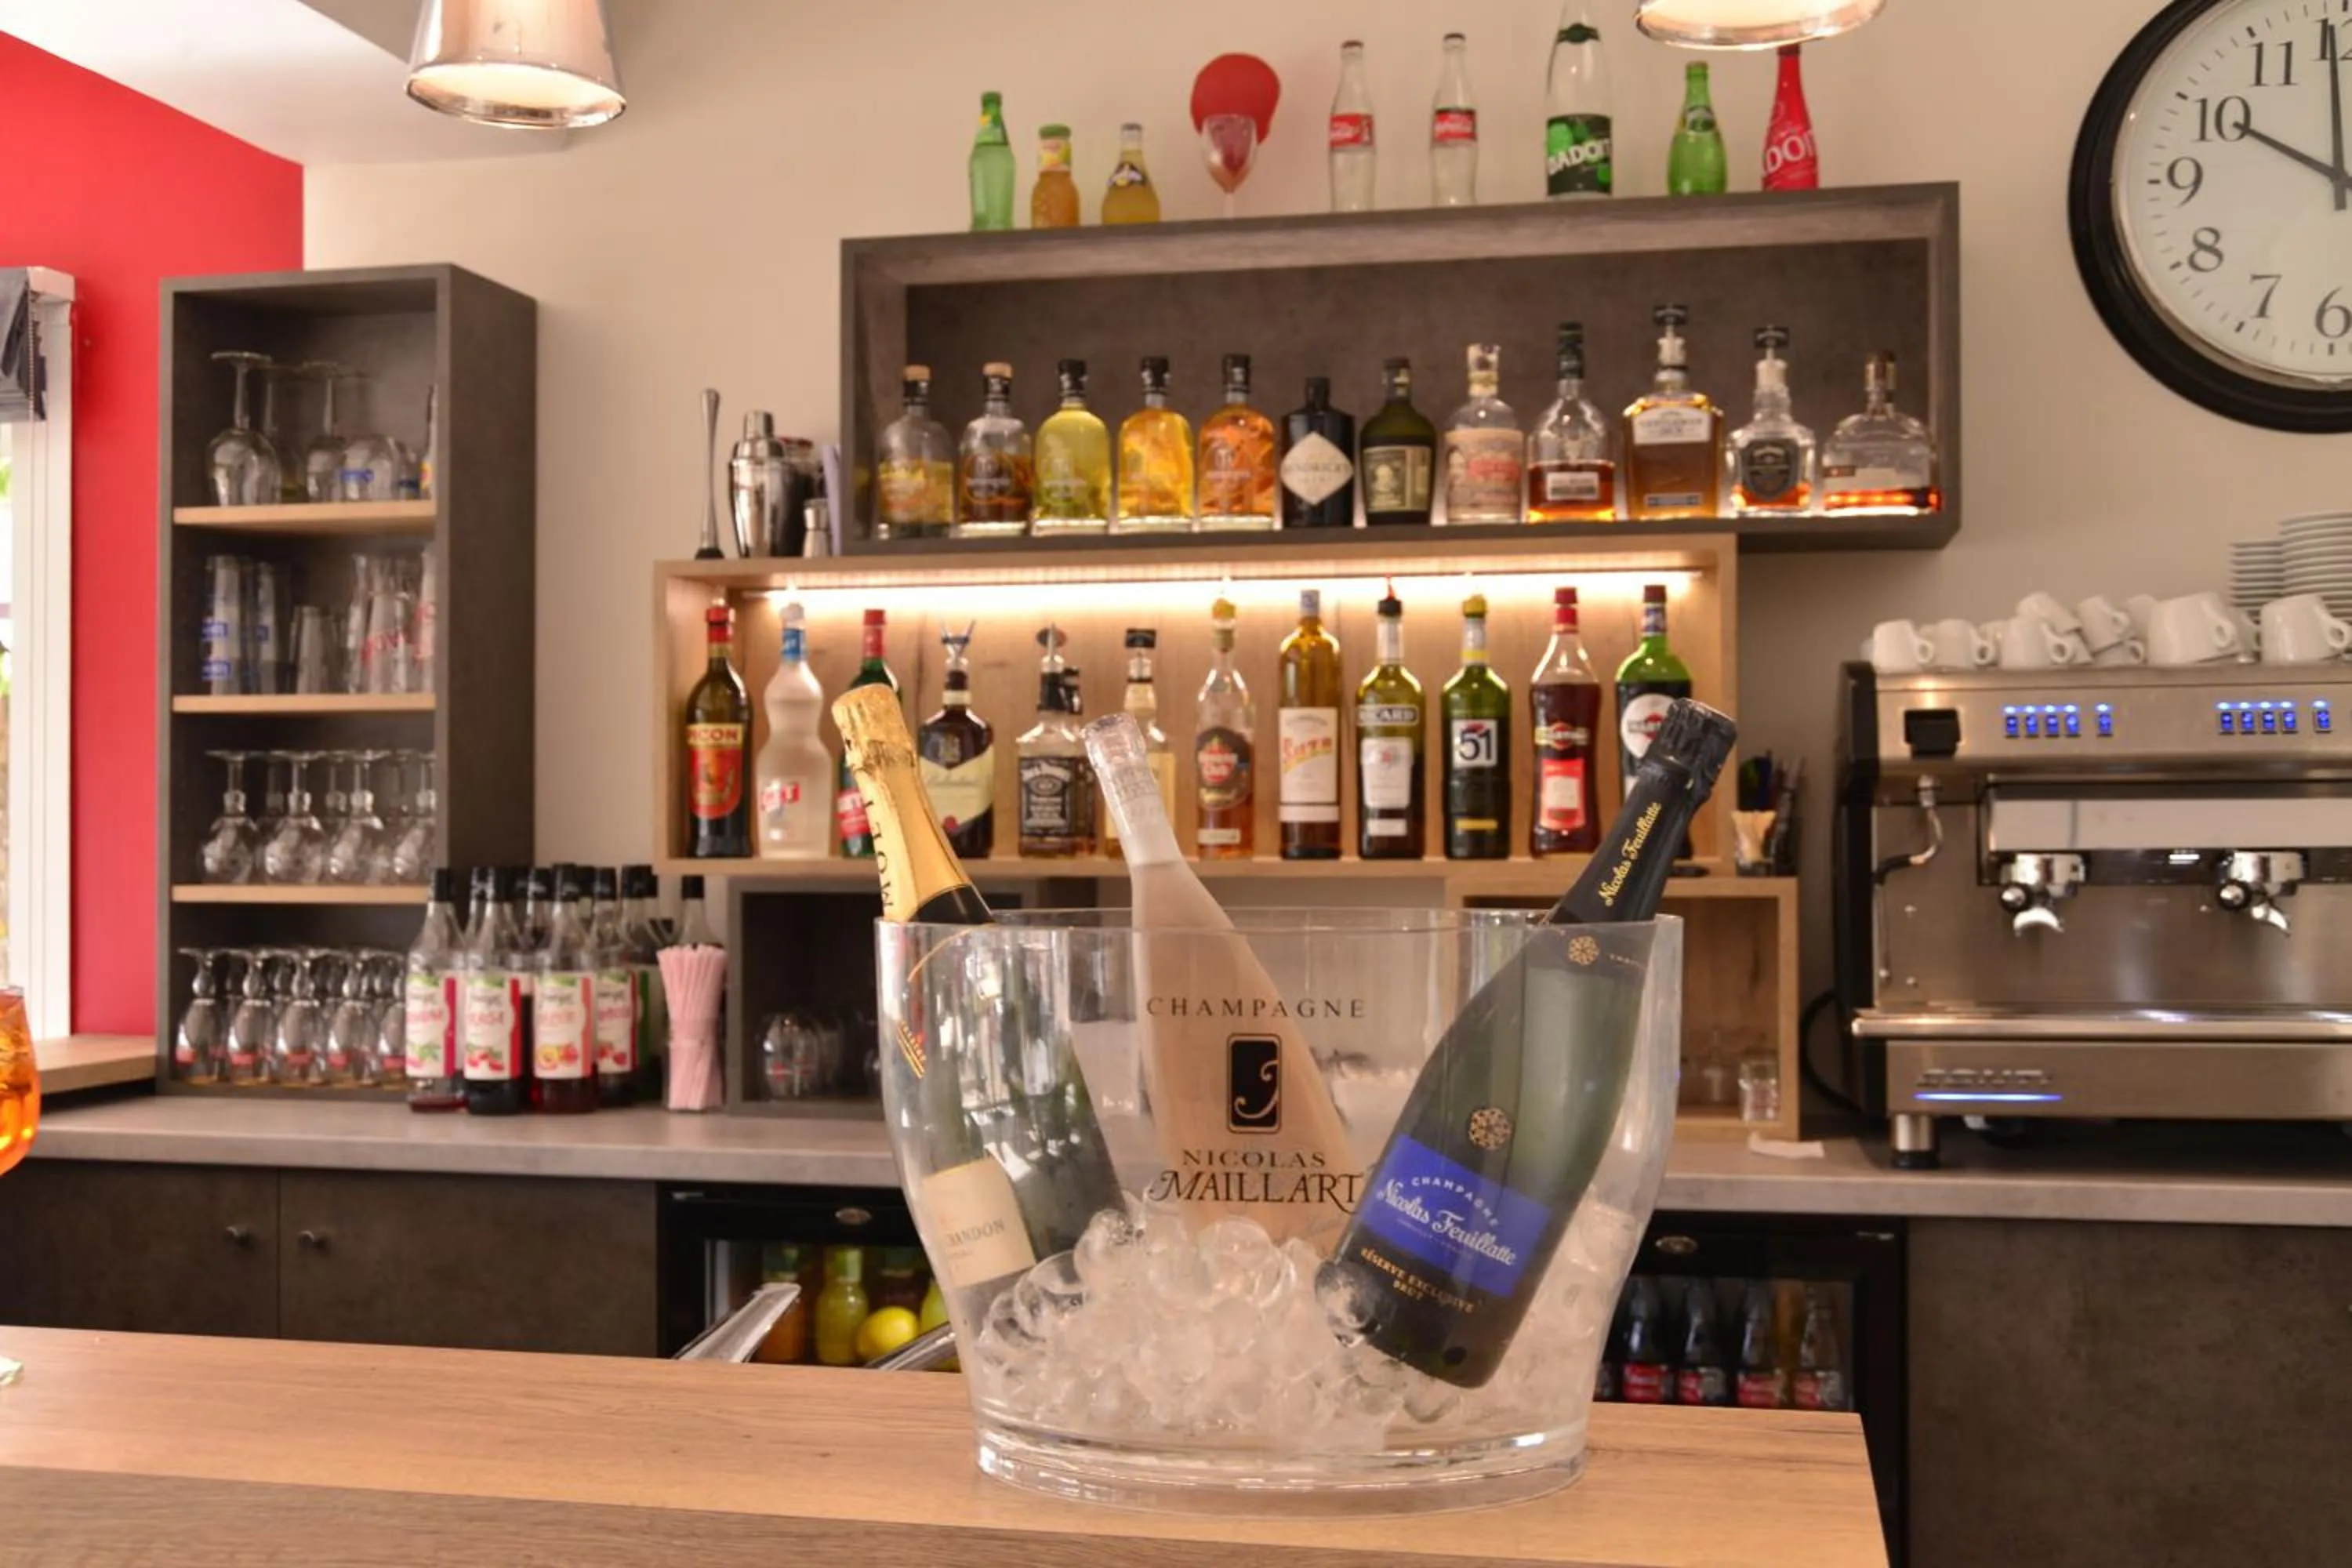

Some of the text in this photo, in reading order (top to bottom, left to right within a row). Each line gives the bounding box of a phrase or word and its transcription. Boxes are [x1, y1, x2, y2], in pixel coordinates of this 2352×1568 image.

[2249, 41, 2299, 87] 11
[2194, 95, 2252, 143] 10
[2165, 157, 2204, 209] 9
[2187, 227, 2224, 273] 8
[2249, 274, 2282, 320] 7
[2314, 286, 2352, 339] 6
[1359, 707, 1417, 722] CARD
[1459, 727, 1492, 760] 51
[1598, 860, 1632, 907] Nicolas
[1146, 996, 1366, 1018] CHAMPAGNE
[1182, 1149, 1326, 1168] NICOLAS
[1148, 1170, 1365, 1215] MAILLART
[1411, 1176, 1499, 1227] CHAMPAGNE
[1376, 1178, 1430, 1225] Nicolas
[1432, 1209, 1517, 1266] Feuillatte
